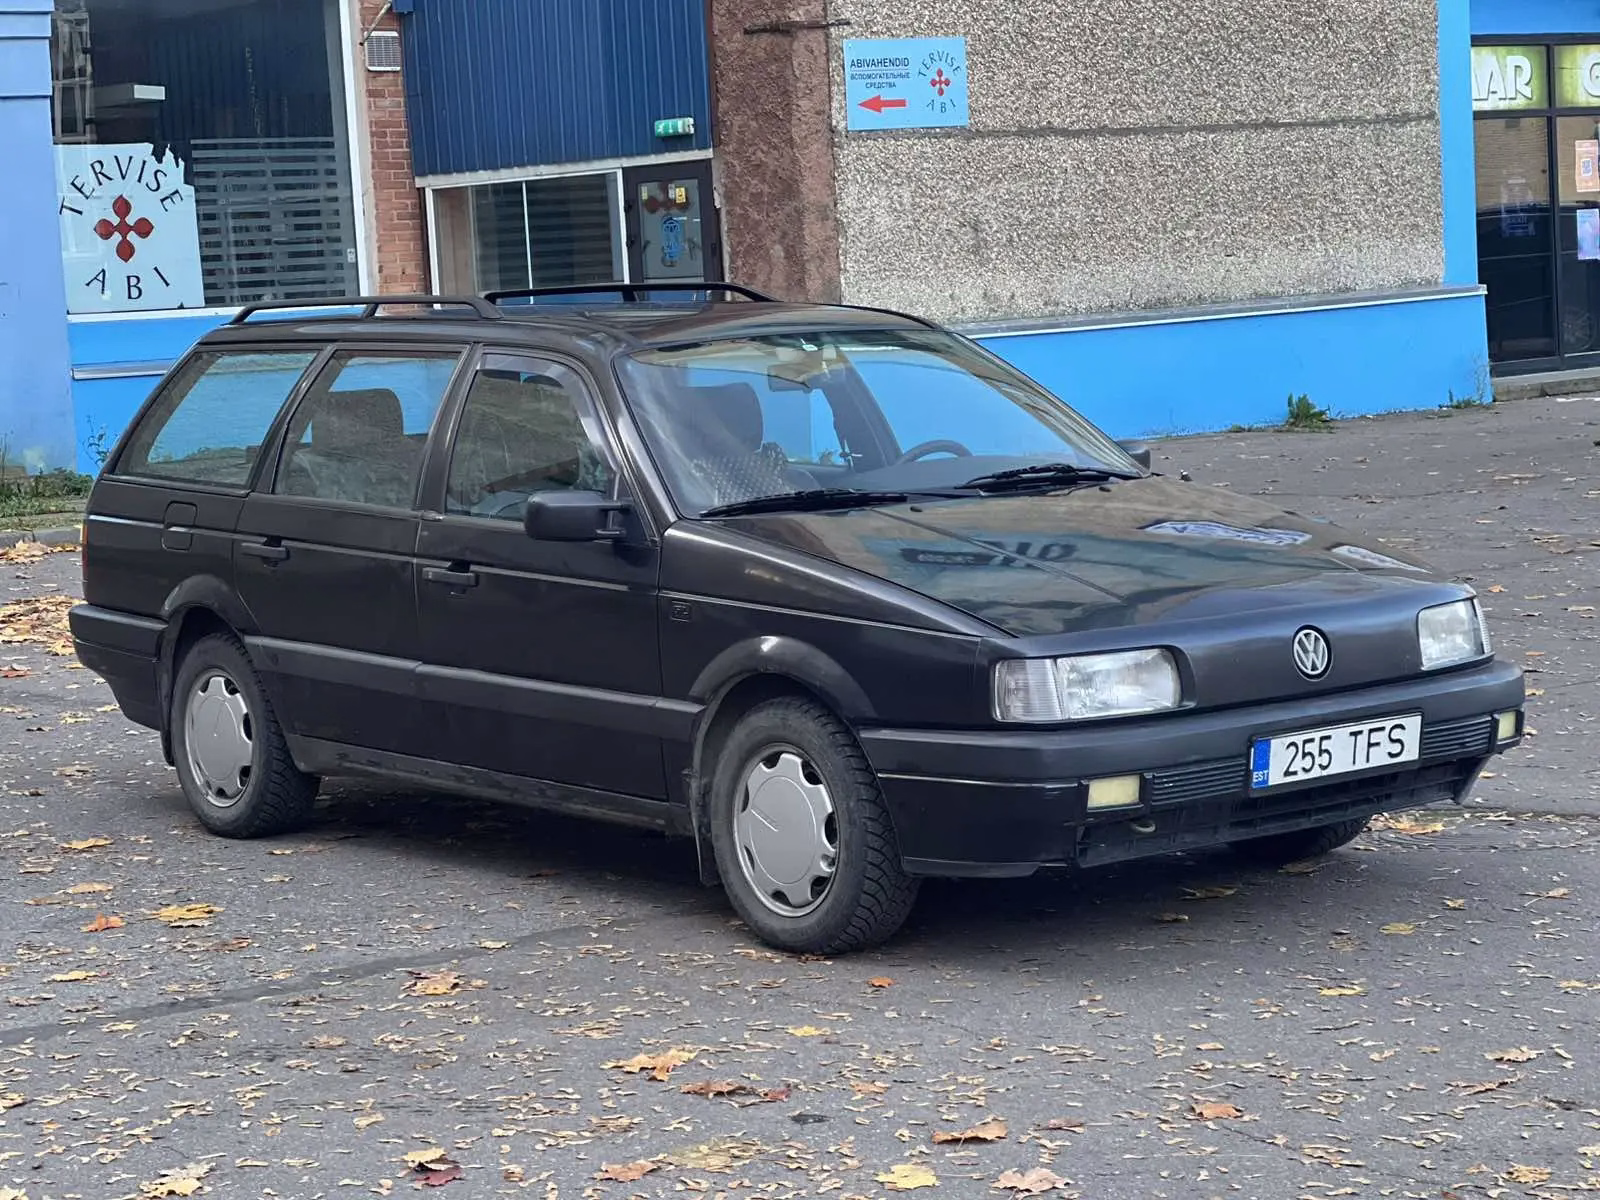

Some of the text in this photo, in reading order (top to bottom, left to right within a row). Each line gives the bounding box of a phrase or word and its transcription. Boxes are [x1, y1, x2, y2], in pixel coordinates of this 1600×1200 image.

[850, 57, 910, 69] ABIVAHENDID
[918, 50, 961, 77] TERVISE
[850, 72, 911, 81] ВСПОМОГАТЕЛЬНЫЕ
[865, 81, 897, 89] СРЕДСТВА
[1472, 55, 1533, 100] AR
[926, 99, 957, 113] ABI
[59, 155, 184, 216] TERVISE
[85, 266, 170, 300] ABI
[1283, 723, 1406, 778] 255 TFS
[1253, 770, 1269, 782] EST
